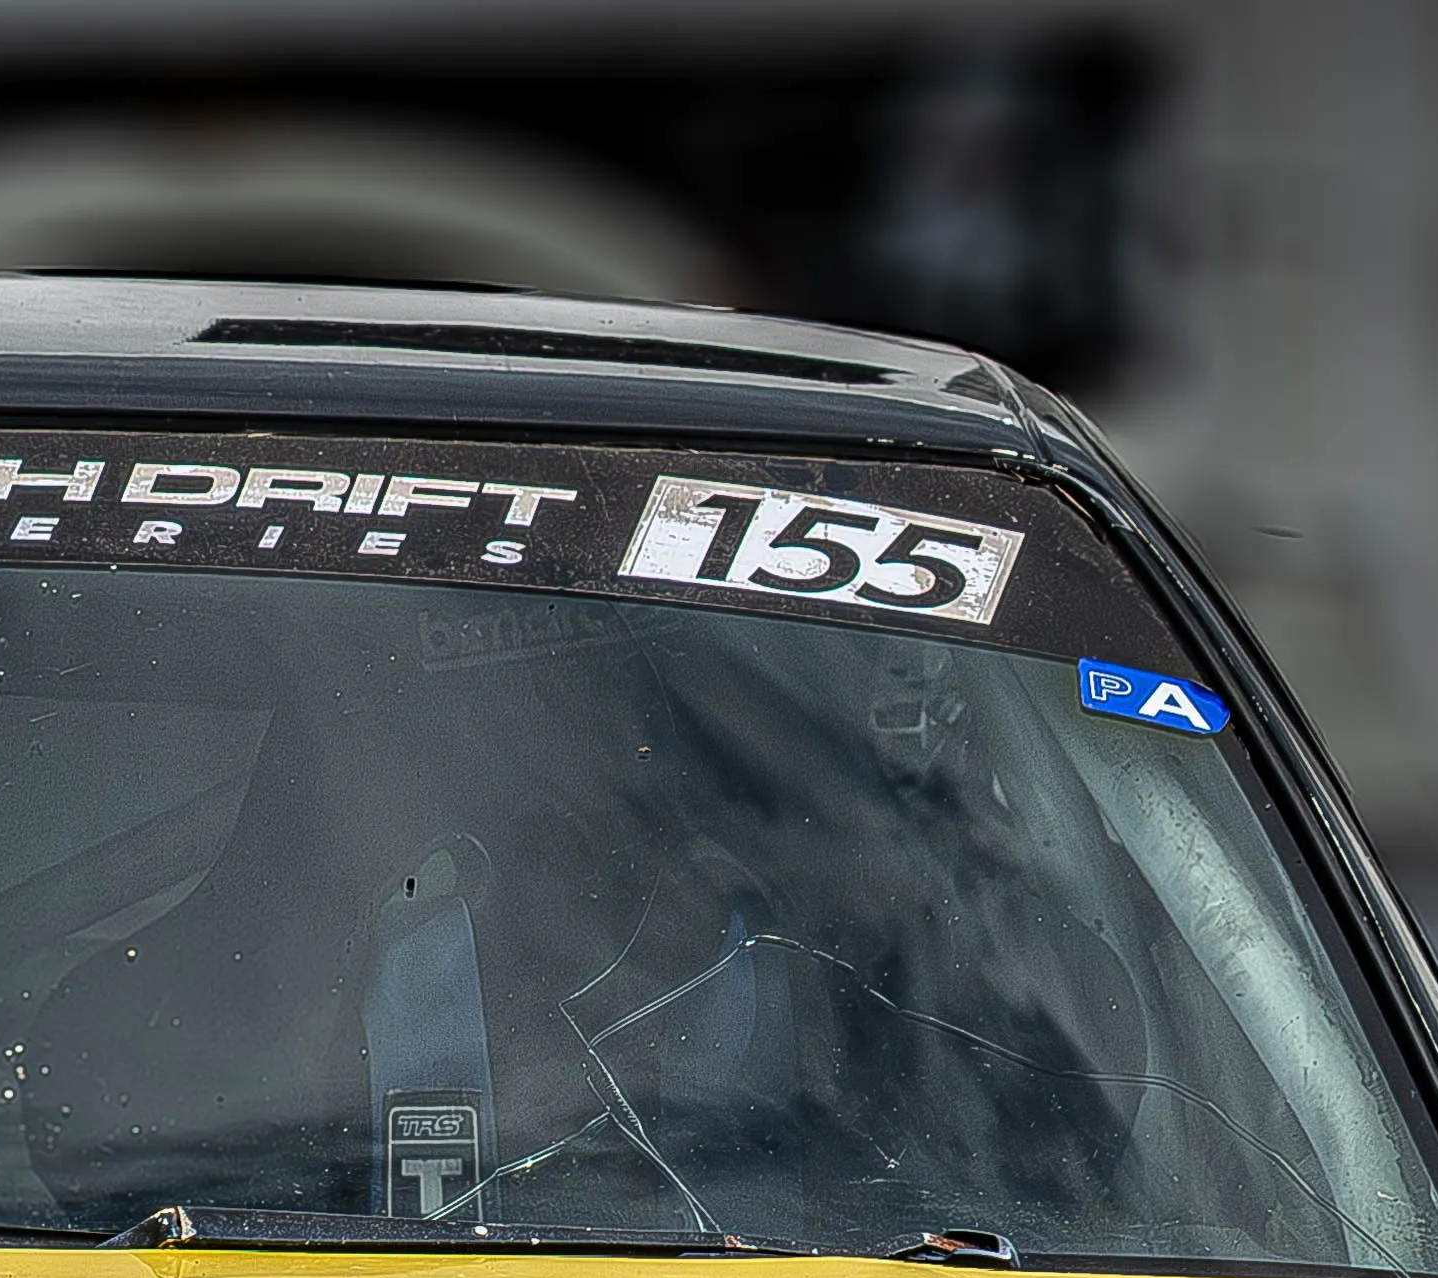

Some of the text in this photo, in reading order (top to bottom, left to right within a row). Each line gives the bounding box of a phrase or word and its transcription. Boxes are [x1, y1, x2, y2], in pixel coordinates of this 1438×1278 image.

[121, 462, 577, 527] DRIFT
[692, 494, 983, 610] 155
[1088, 670, 1211, 732] P A
[397, 1113, 465, 1137] TRS
